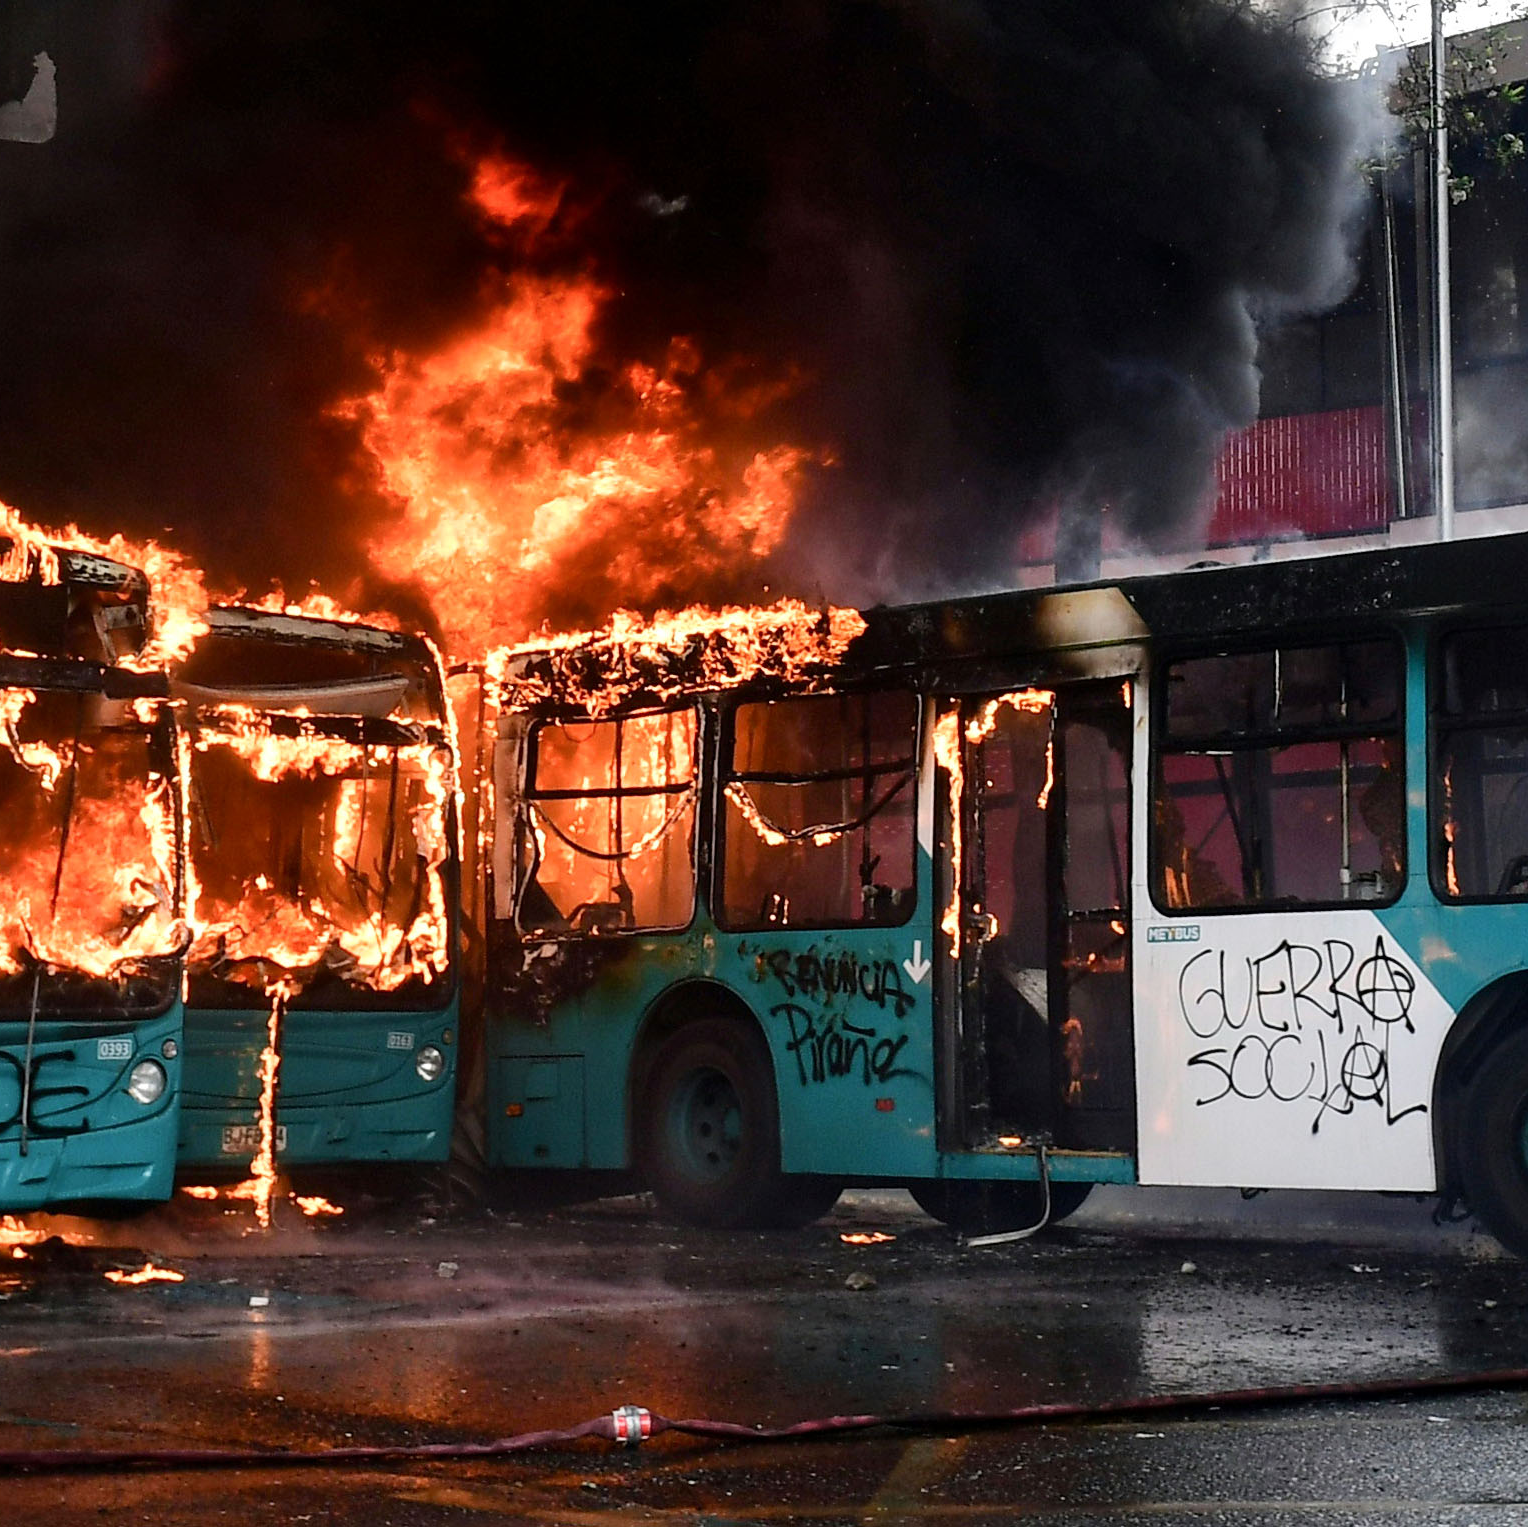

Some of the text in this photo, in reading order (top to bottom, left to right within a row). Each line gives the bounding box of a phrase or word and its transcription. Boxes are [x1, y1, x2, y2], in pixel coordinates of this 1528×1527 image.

[1148, 926, 1199, 941] METBUS
[1179, 934, 1416, 1039] GUERRA
[100, 1042, 129, 1056] 0393
[1186, 1024, 1428, 1135] SOCIAL
